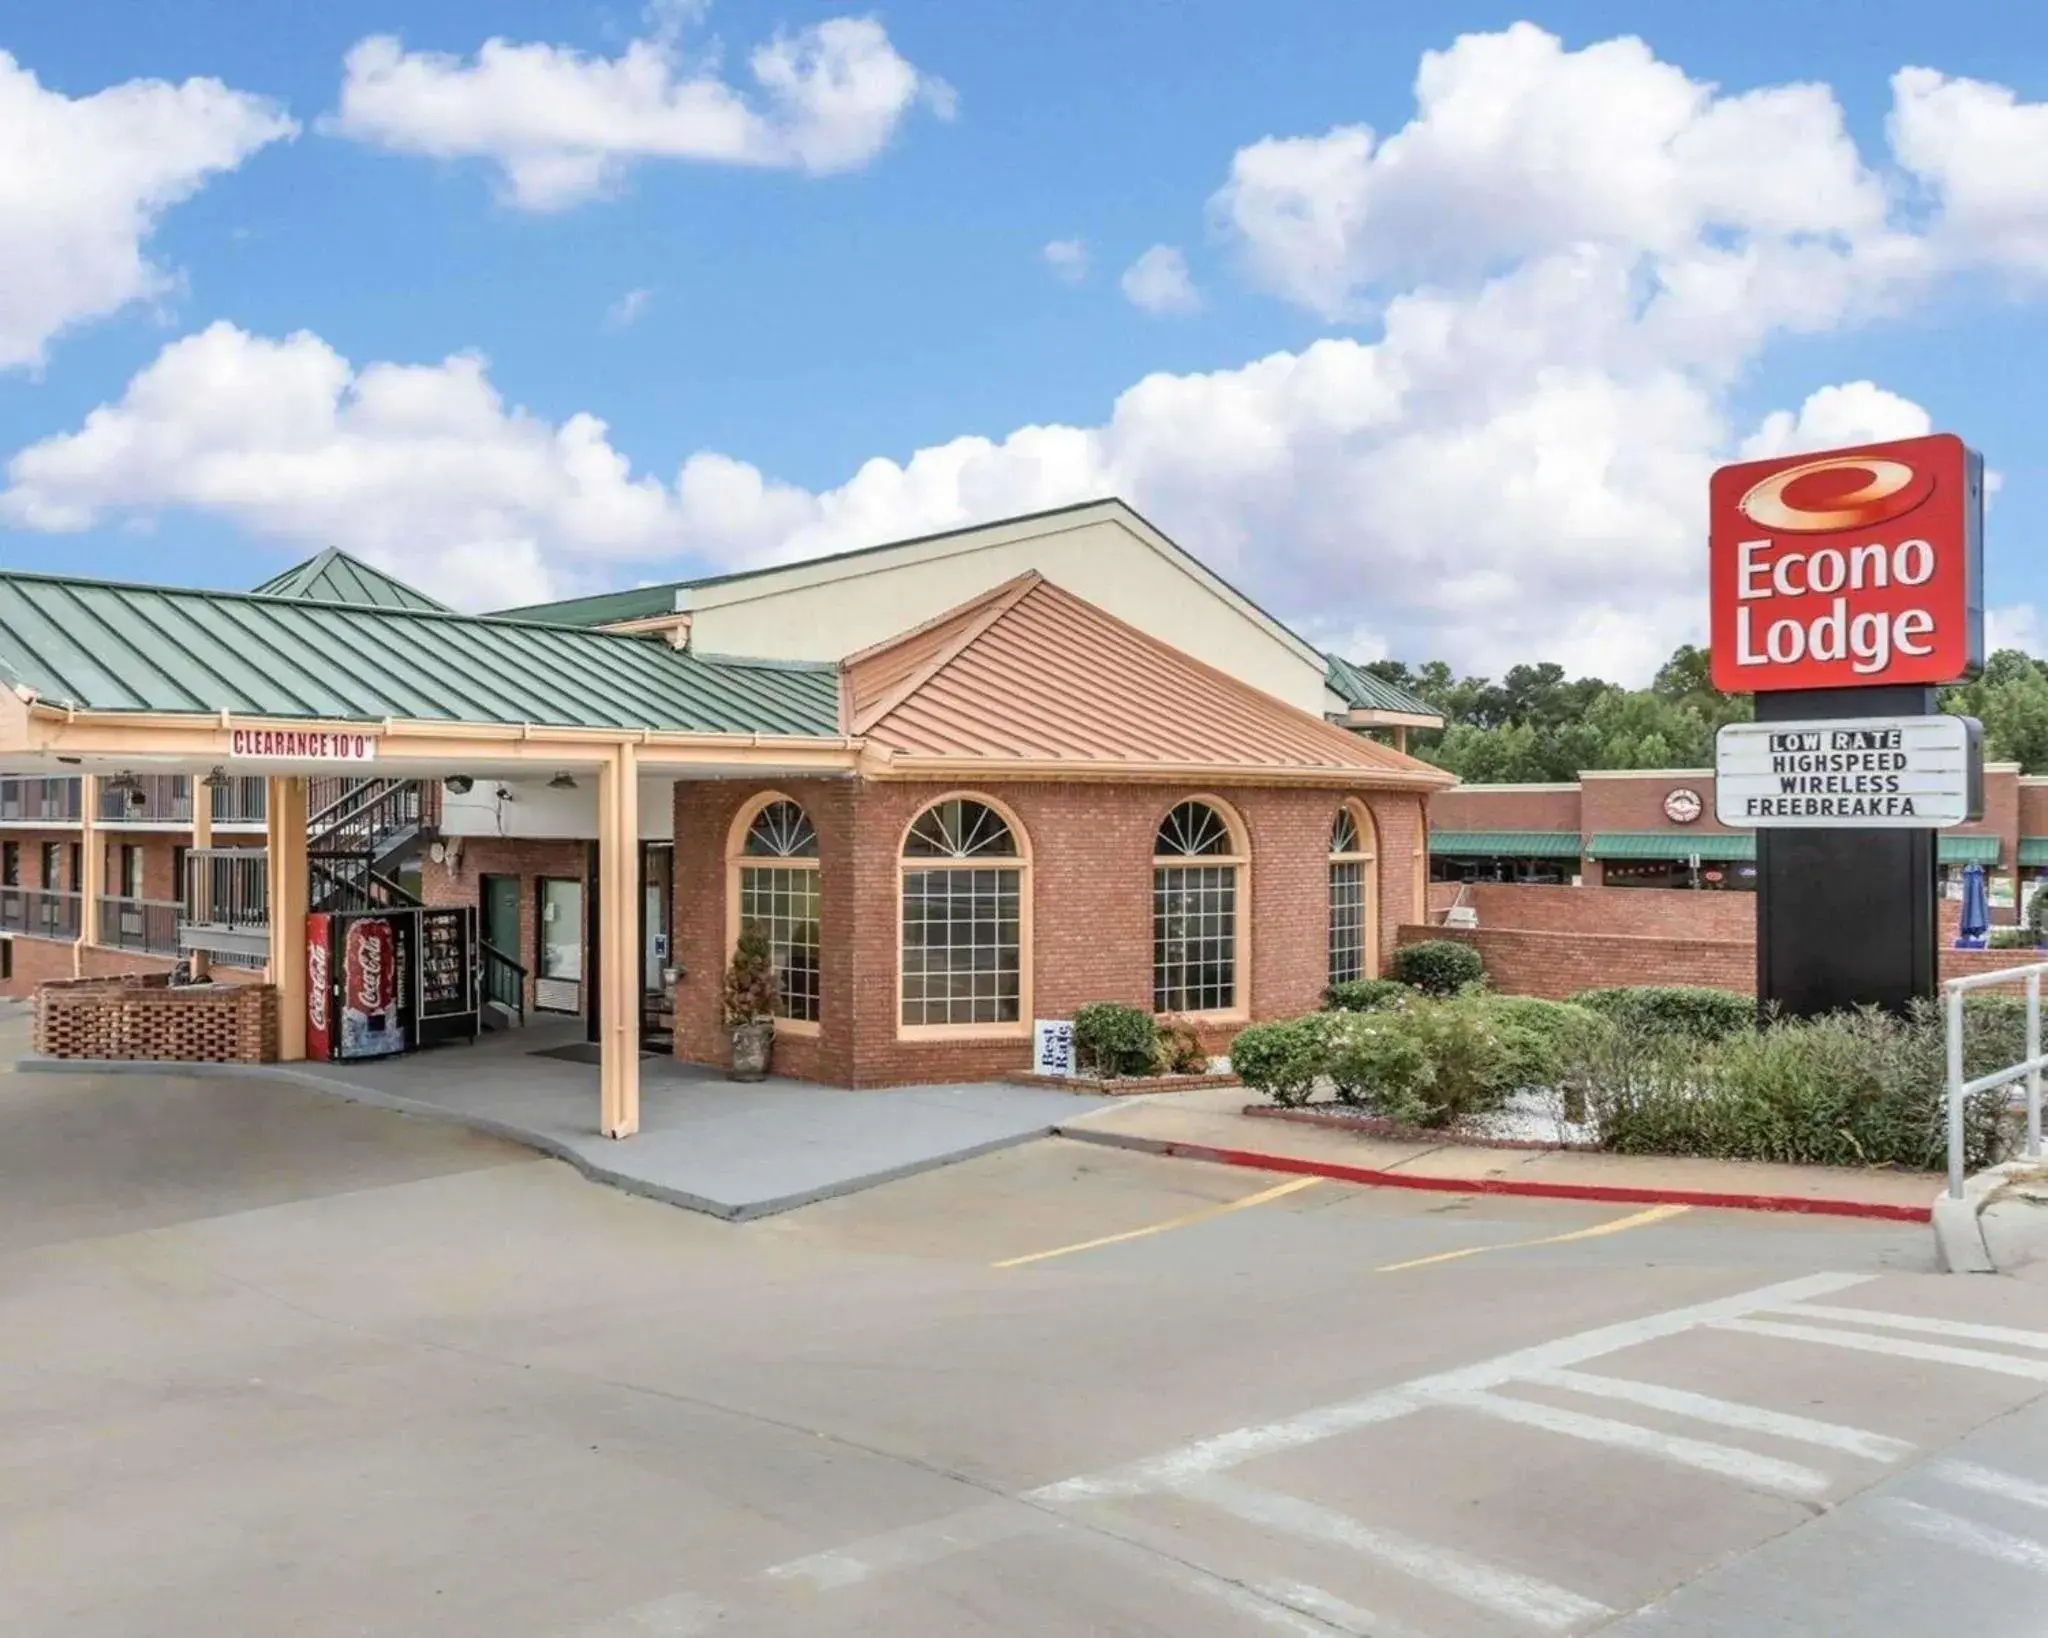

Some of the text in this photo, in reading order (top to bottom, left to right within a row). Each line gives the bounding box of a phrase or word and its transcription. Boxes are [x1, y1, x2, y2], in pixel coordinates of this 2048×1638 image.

[1737, 538, 1935, 600] Econo
[1736, 598, 1935, 674] Lodge
[234, 730, 372, 758] CLEARANCE 10'0"
[1771, 730, 1901, 752] LOW RATE
[1773, 753, 1908, 773] HIGHSPEED
[1780, 775, 1900, 793] WIRELESS
[1747, 797, 1915, 816] FREEBREAKFA
[1042, 1029, 1054, 1066] Best
